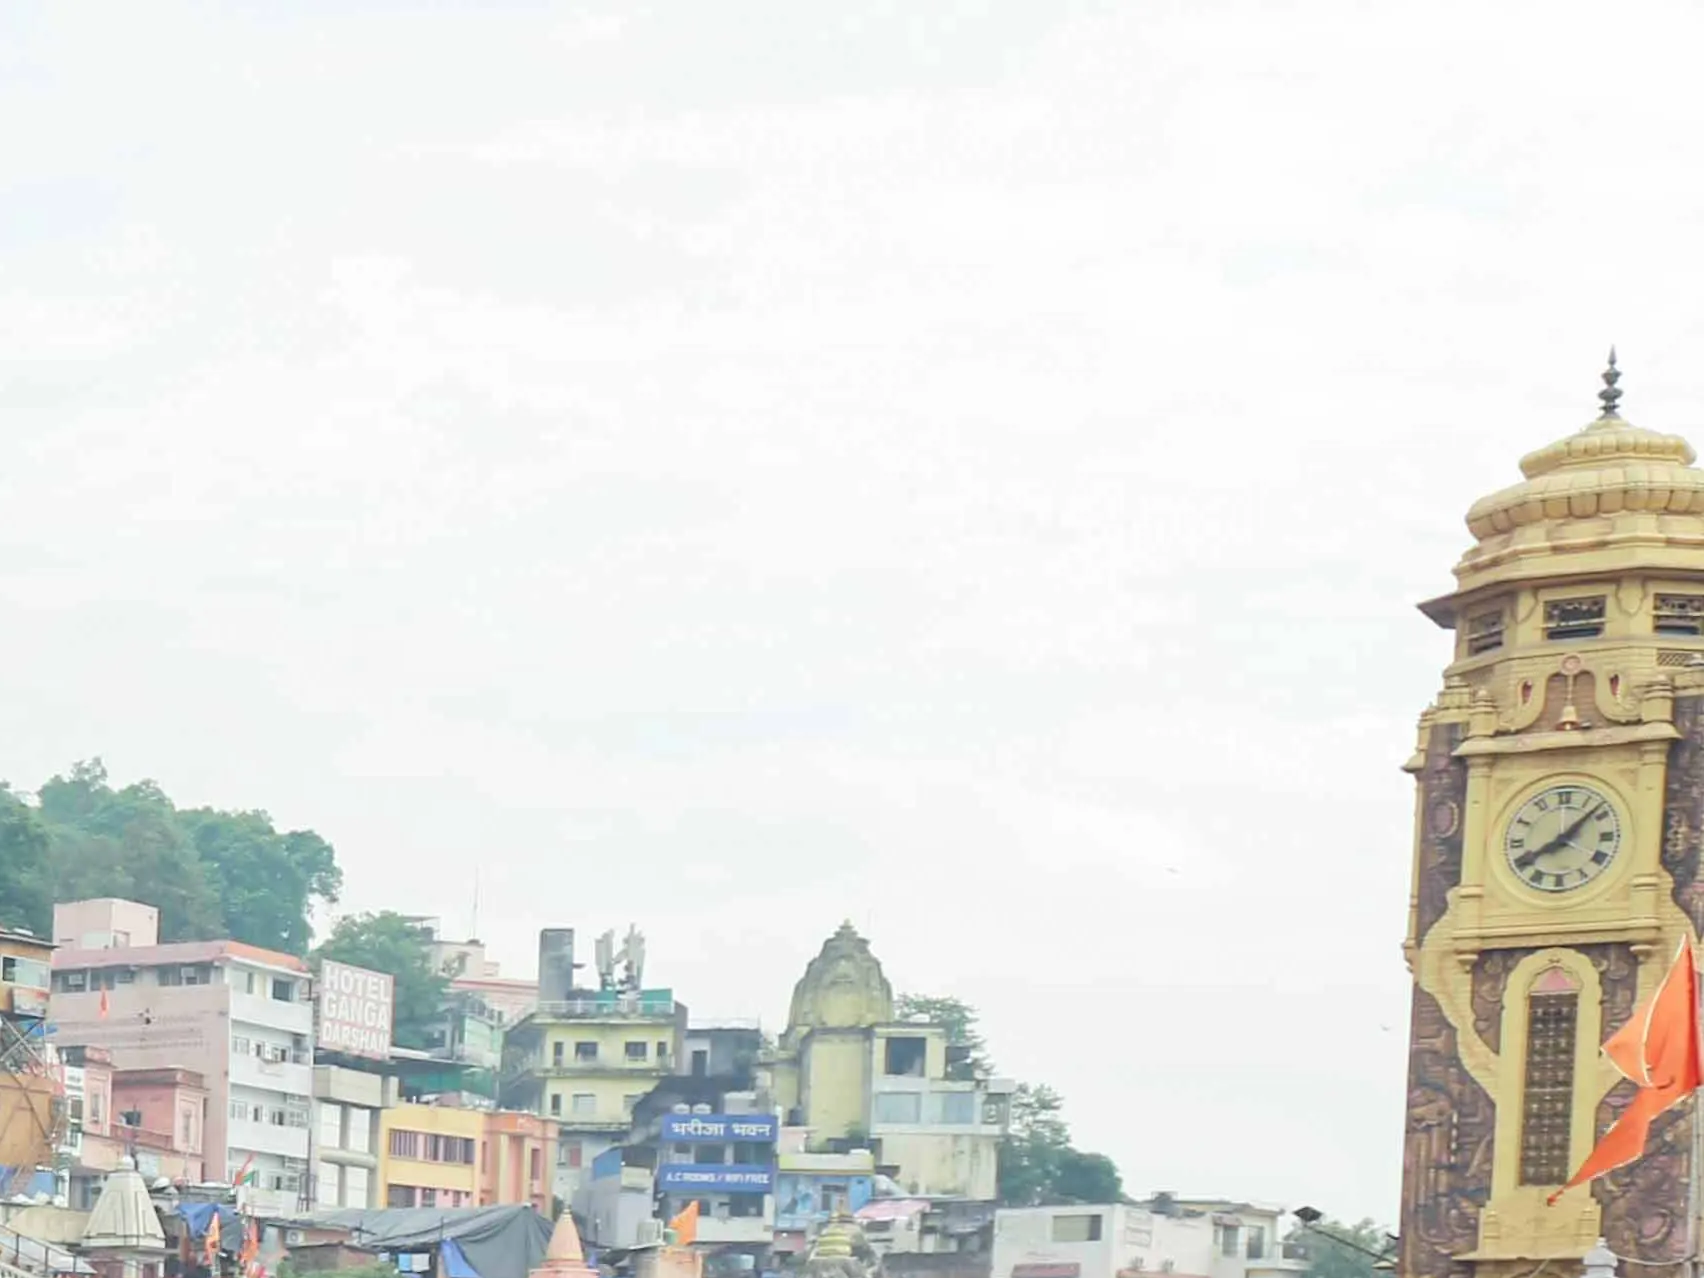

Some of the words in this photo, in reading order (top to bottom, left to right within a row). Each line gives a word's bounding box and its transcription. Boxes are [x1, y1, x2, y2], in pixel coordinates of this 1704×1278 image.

[324, 964, 389, 1002] HOTEL
[323, 991, 389, 1030] GANGA
[322, 1020, 389, 1055] DARSHAN
[732, 1122, 772, 1136] भवन
